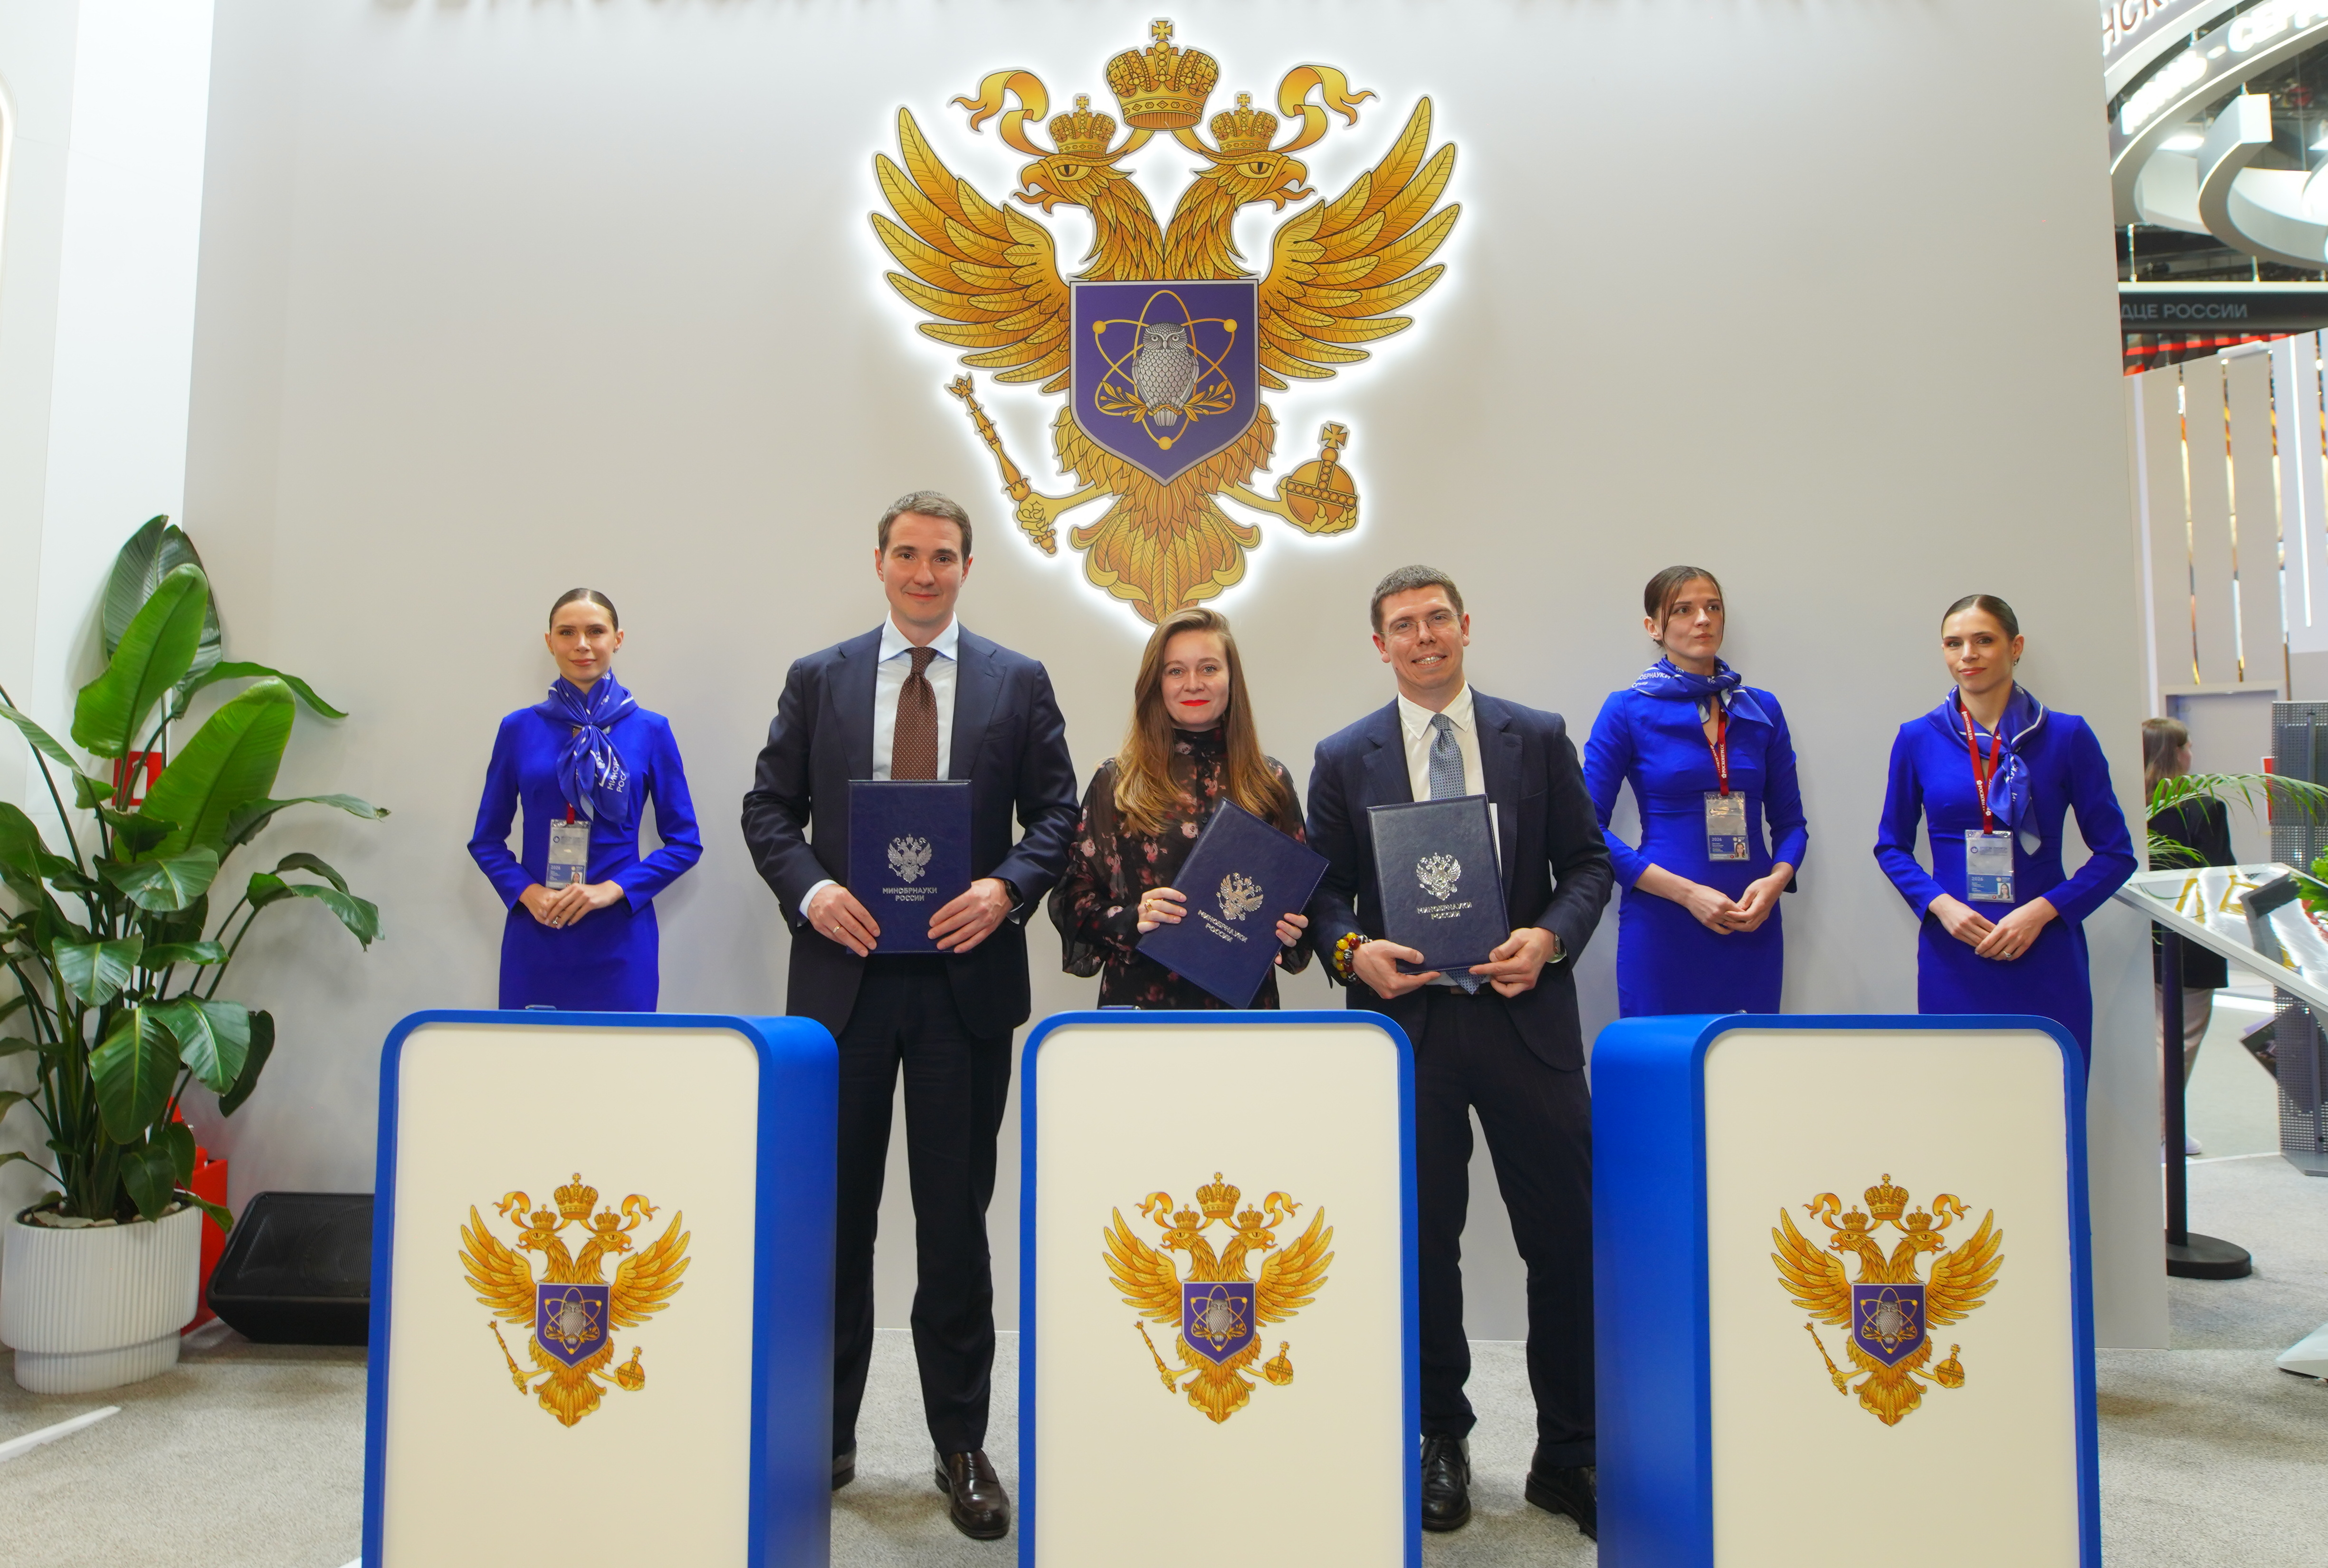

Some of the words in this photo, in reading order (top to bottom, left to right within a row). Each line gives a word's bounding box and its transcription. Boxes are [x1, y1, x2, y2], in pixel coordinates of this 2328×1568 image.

[2163, 304, 2248, 318] РОССИИ
[1637, 672, 1671, 680] ОБРНАУКИ
[1197, 909, 1248, 943] МИНОБРНАУКИ
[1205, 923, 1233, 943] РОССИИ
